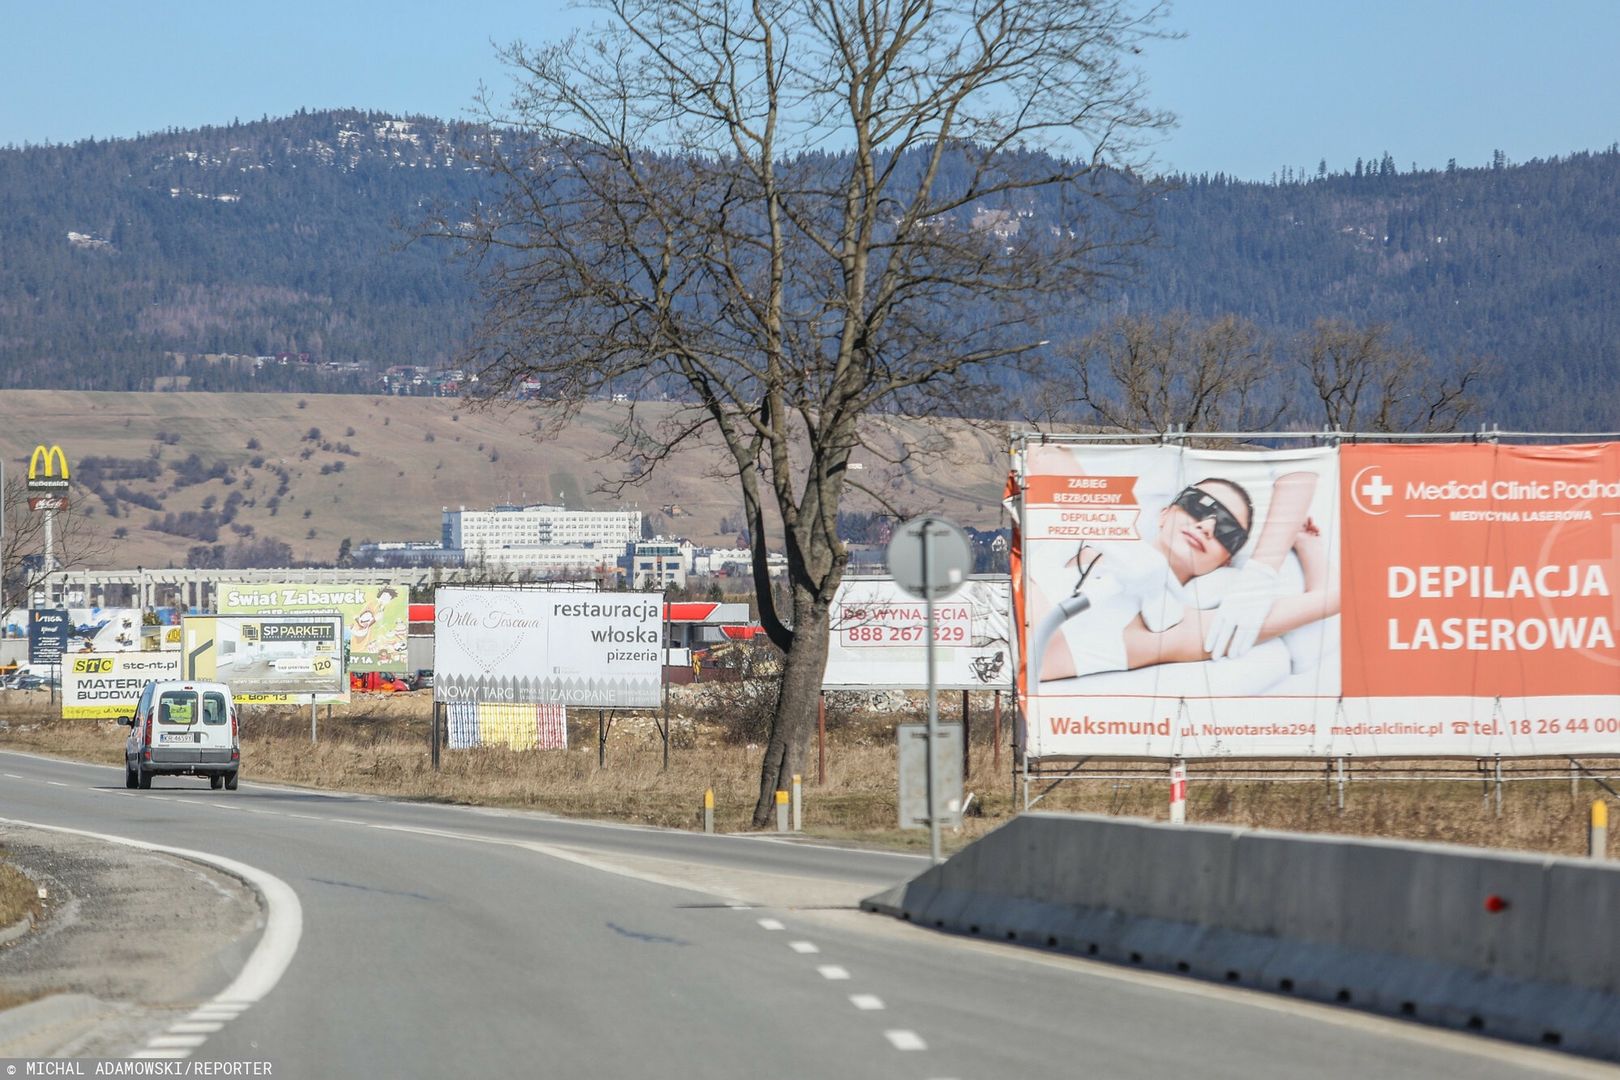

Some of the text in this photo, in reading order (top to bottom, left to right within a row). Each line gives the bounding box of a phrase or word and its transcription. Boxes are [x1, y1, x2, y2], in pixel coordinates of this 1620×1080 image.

[1068, 478, 1107, 488] ZABIEG
[1405, 480, 1487, 500] Medical
[1491, 481, 1549, 500] Clinic
[1053, 493, 1122, 503] BEZBOLESNY
[1061, 513, 1117, 522] DEPILACJA
[1450, 511, 1592, 522] MEDYCYNA LASEROWA
[1048, 526, 1079, 535] PRZEZ
[1108, 527, 1130, 536] ROK
[1387, 565, 1609, 598] DEPILACJA
[228, 587, 366, 607] Świat Zabawek
[554, 600, 658, 622] restauracja
[843, 609, 867, 621] DO
[437, 607, 540, 629] Villa Toscana
[263, 625, 332, 636] SP PARKETT
[591, 625, 658, 643] włoska
[849, 627, 883, 641] 888
[889, 627, 923, 641] 267
[1388, 617, 1615, 651] LASEROWA
[607, 648, 658, 664] pizzeria
[75, 660, 112, 672] STC
[122, 661, 178, 670] stc-nt.pl
[313, 660, 331, 671] 120
[77, 678, 177, 690] MATERIA
[437, 685, 479, 699] NOWY
[483, 687, 514, 700] TARG
[551, 688, 615, 701] ZAKOPANE
[1050, 716, 1170, 736] Waksmund
[1181, 725, 1199, 737] ul.
[1202, 723, 1316, 736] Nowotarska294
[1331, 722, 1443, 737] medicalclinic.pl
[1473, 719, 1503, 736] tel.
[1509, 719, 1532, 735] 18
[1537, 718, 1560, 734] 26
[1565, 718, 1589, 734] 44
